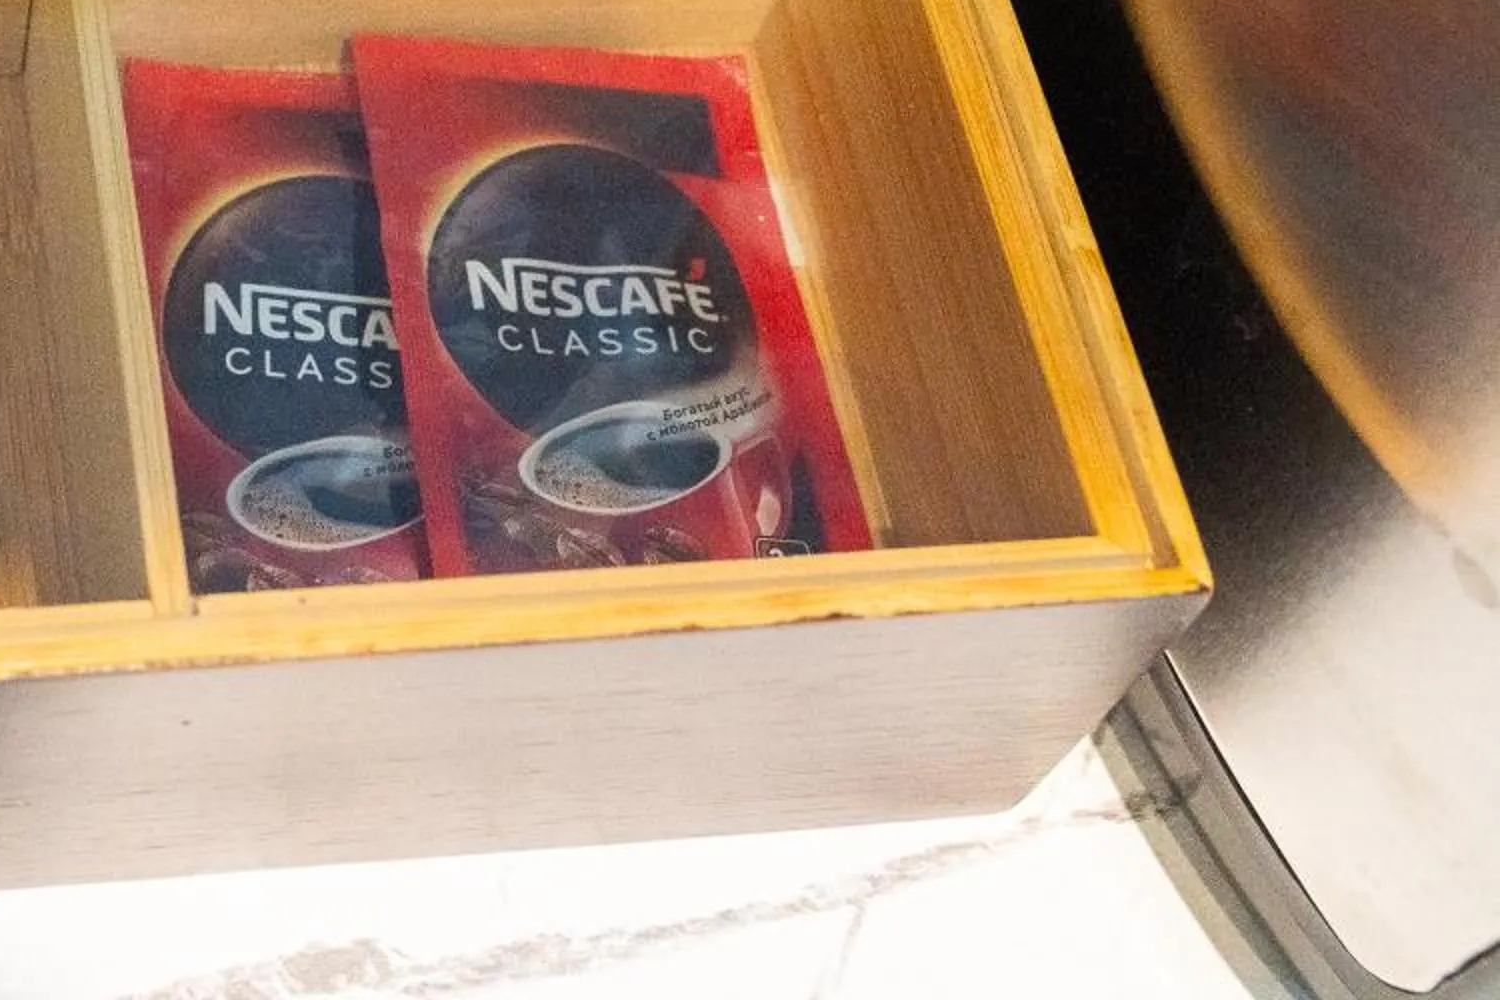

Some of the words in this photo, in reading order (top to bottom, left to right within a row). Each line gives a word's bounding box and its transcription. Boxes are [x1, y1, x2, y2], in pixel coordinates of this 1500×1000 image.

[203, 281, 401, 351] NESCA
[465, 257, 719, 323] NESCAFÉ
[224, 346, 393, 390] CLASS
[497, 324, 714, 357] CLASSIC
